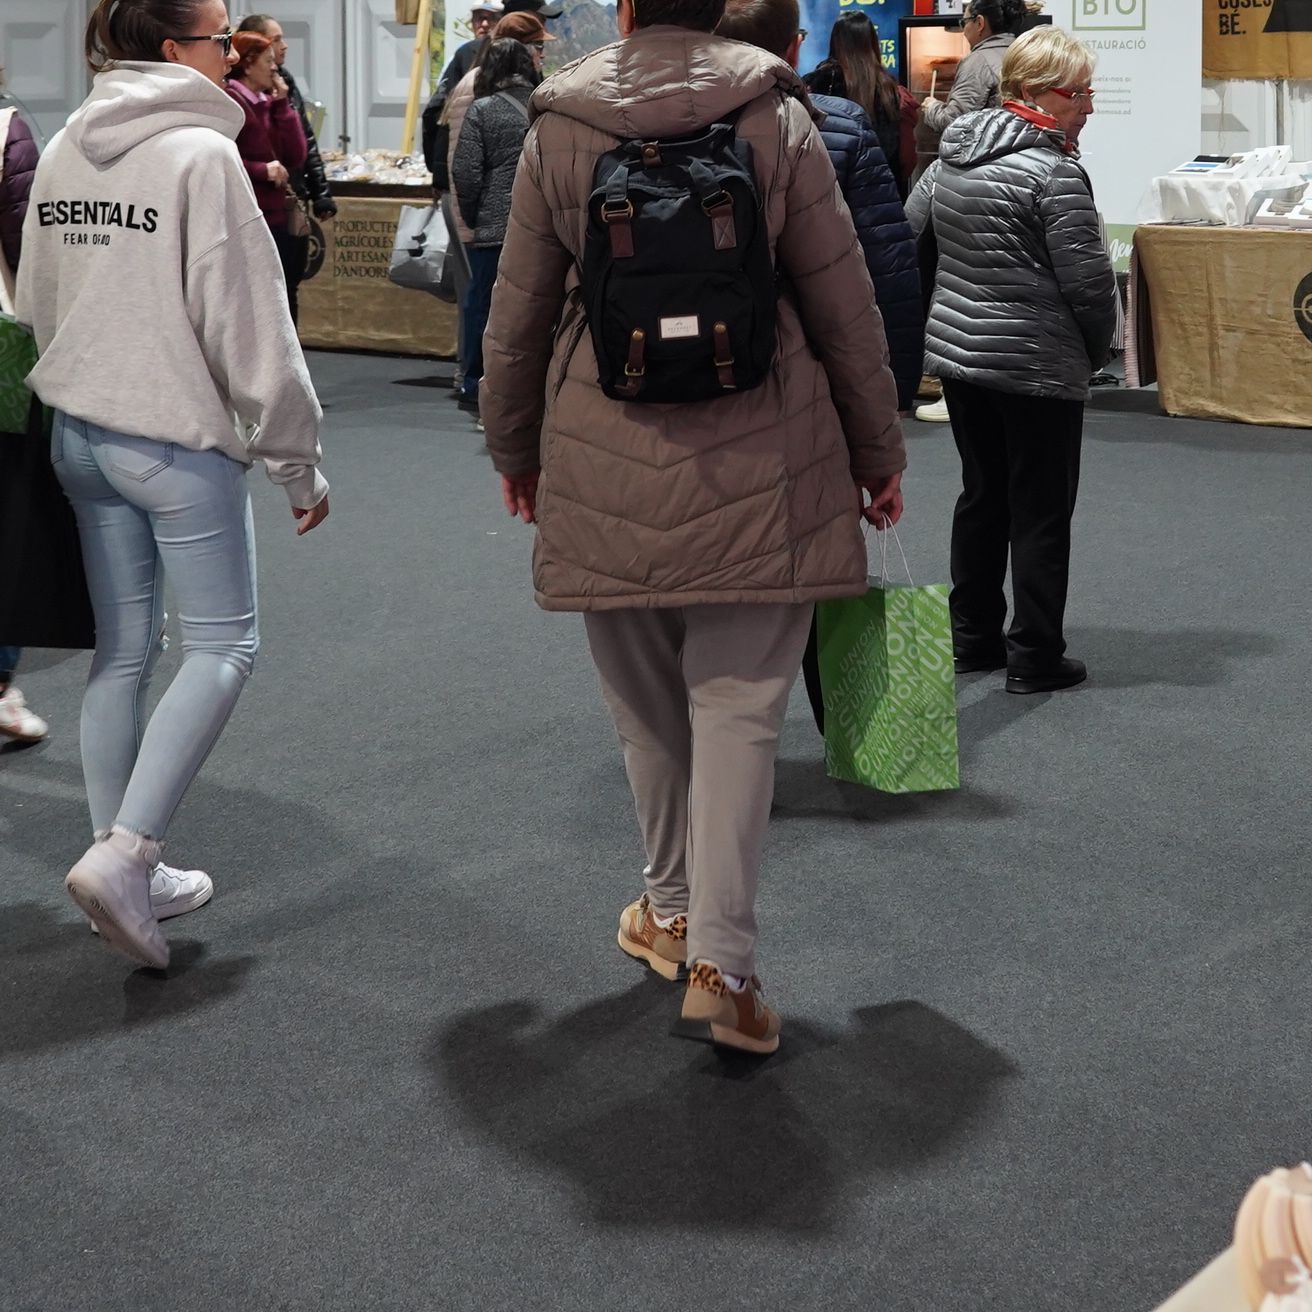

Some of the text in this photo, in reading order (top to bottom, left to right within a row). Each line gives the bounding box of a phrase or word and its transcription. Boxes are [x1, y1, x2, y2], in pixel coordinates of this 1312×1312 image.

[1219, 9, 1246, 36] BÉ.
[1084, 35, 1147, 49] STAURACIÓ
[37, 200, 158, 233] ESENTALS
[64, 233, 88, 245] FEAR
[337, 251, 392, 263] ARTESAN
[333, 265, 389, 278] D'ANDOR
